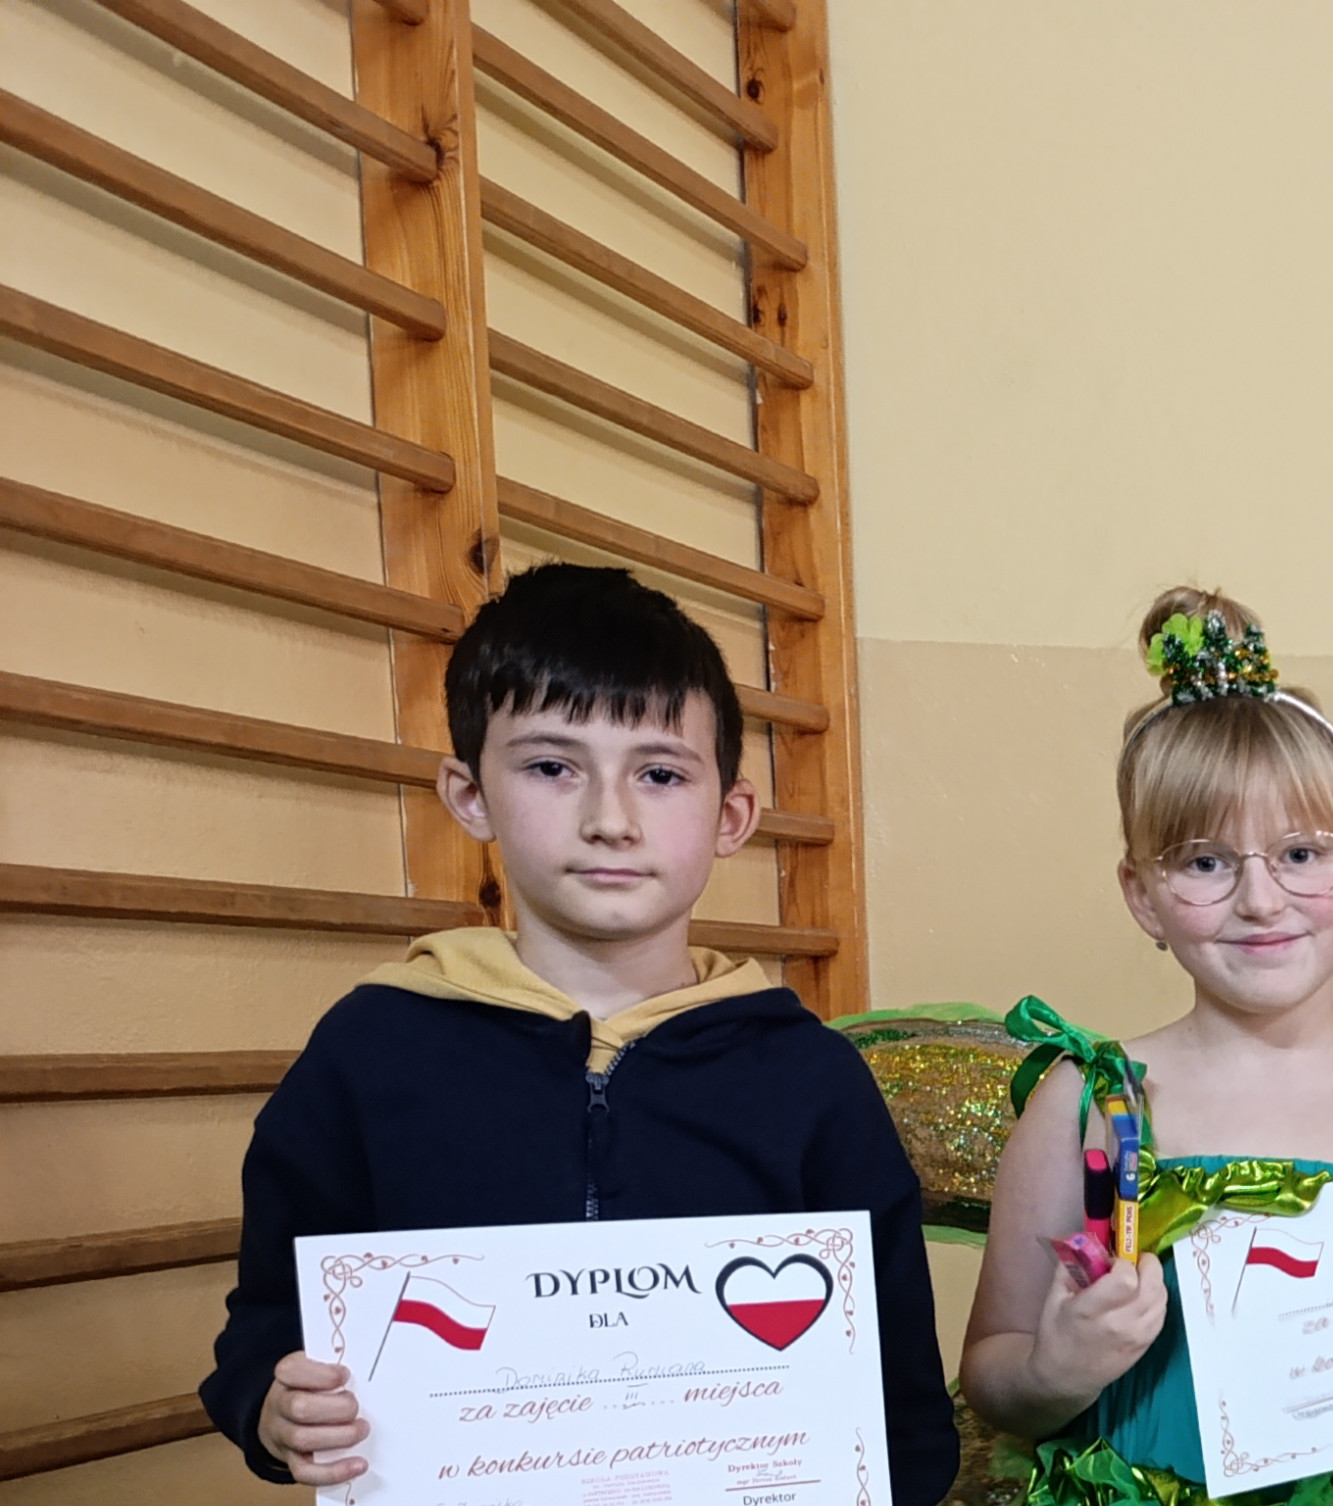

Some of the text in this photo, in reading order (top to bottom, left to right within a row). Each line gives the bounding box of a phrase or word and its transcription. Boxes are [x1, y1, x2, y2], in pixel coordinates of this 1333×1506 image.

[1125, 1172, 1135, 1181] 6
[526, 1262, 703, 1299] DYPLOM
[589, 1312, 629, 1329] DLA
[1302, 1316, 1329, 1334] za
[1289, 1365, 1306, 1380] w
[459, 1404, 496, 1423] za
[502, 1394, 594, 1424] zajęcie
[683, 1379, 783, 1407] miejsca
[438, 1428, 809, 1480] w konkursie patriotycznym
